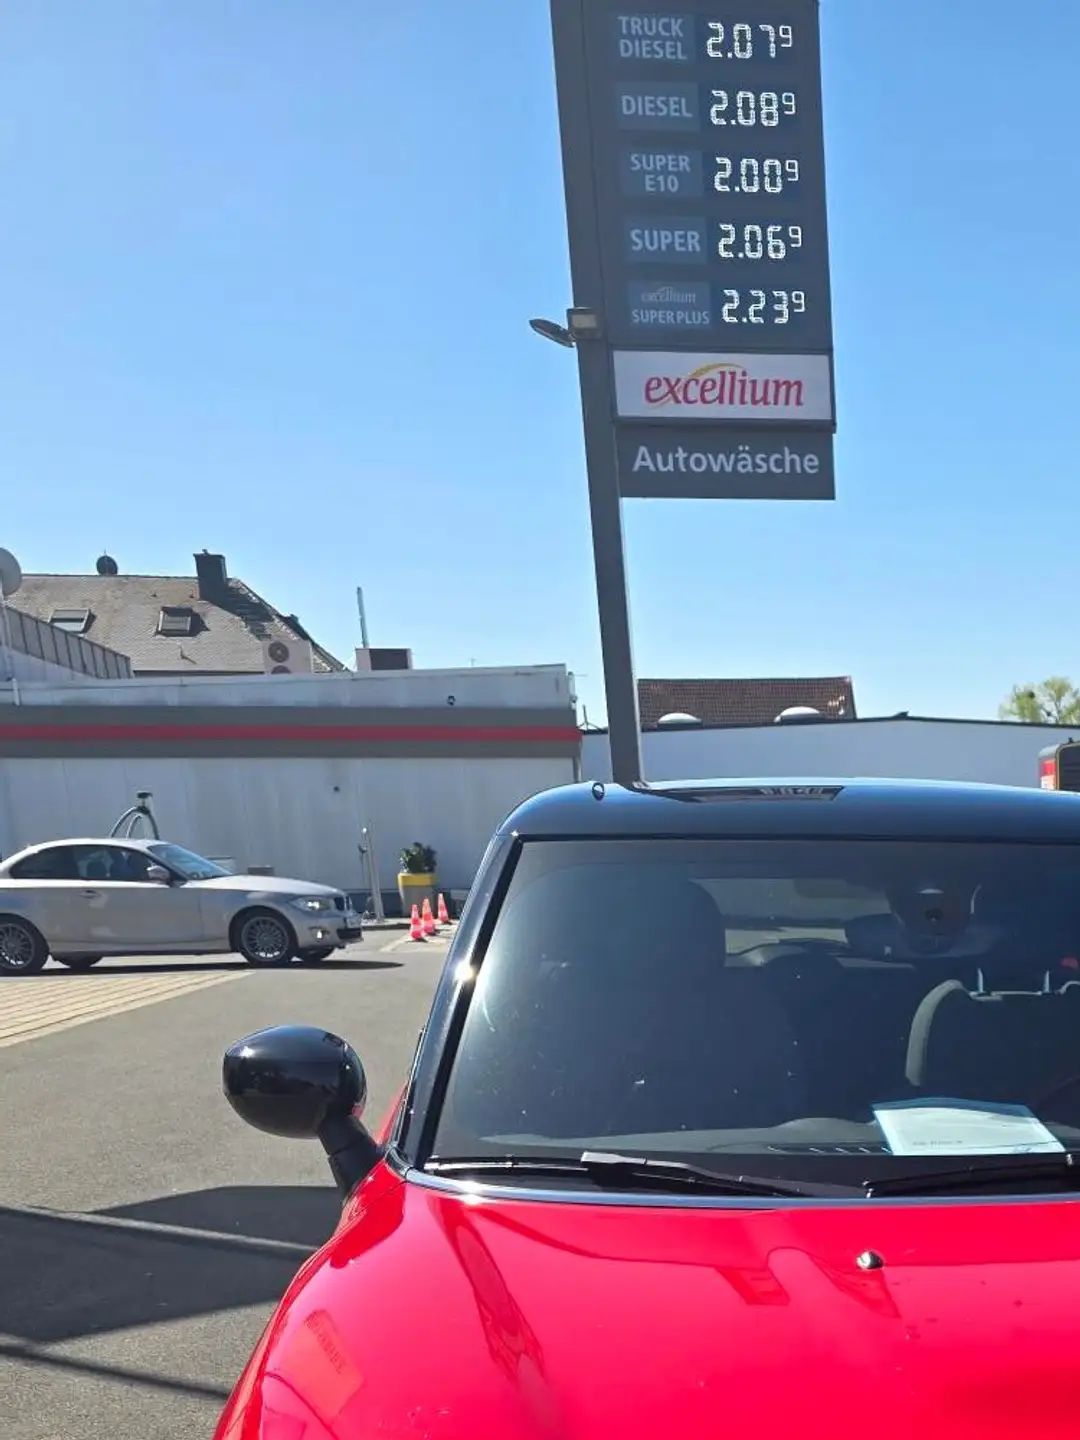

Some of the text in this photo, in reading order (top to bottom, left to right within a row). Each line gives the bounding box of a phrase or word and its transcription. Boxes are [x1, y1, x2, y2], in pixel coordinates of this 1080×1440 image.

[617, 15, 684, 37] TRUCK
[706, 22, 793, 59] 2.079
[619, 38, 688, 60] DIESEL
[621, 89, 796, 127] DIESEL 2.089
[629, 153, 691, 172] SUPER
[714, 156, 799, 194] 2.009
[644, 175, 680, 193] E10
[630, 223, 802, 260] SUPER 2.069
[721, 288, 806, 325] 2.239
[644, 369, 804, 407] excellium
[632, 445, 820, 475] Autowäsche
